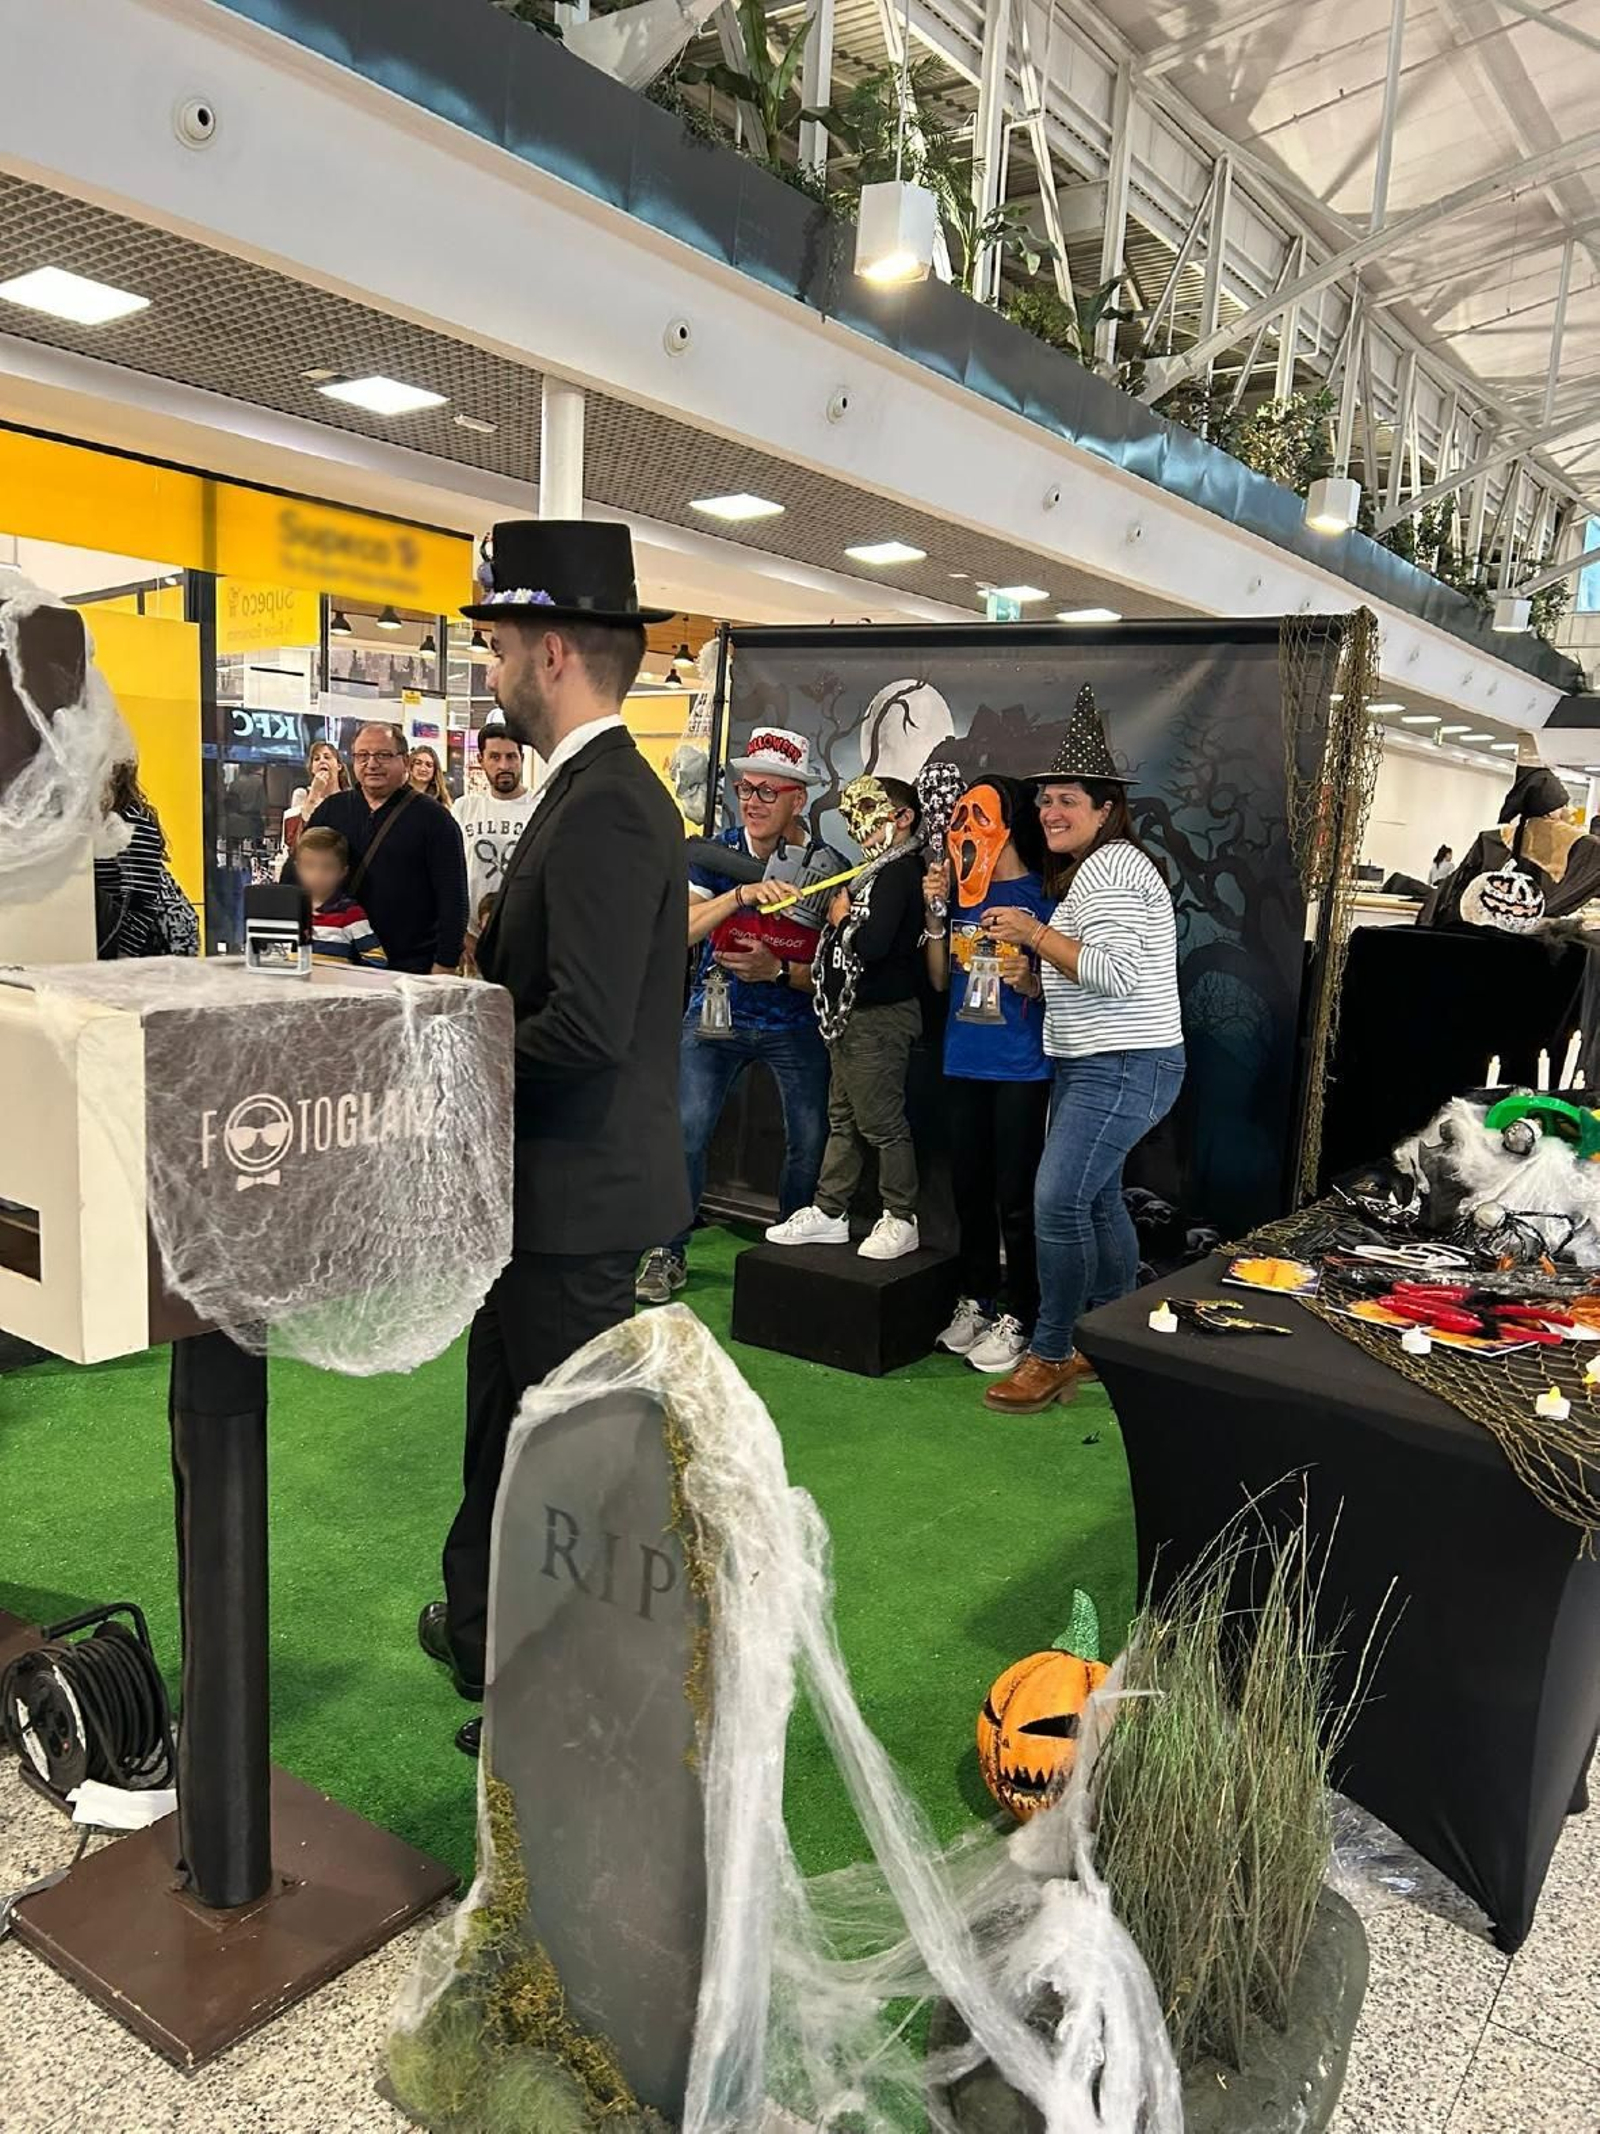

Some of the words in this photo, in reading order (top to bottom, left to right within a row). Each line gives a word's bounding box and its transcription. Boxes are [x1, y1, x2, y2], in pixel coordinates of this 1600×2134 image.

[747, 733, 802, 764] ALLOWEEN
[465, 820, 524, 838] SILBO
[540, 1503, 677, 1623] RIP
